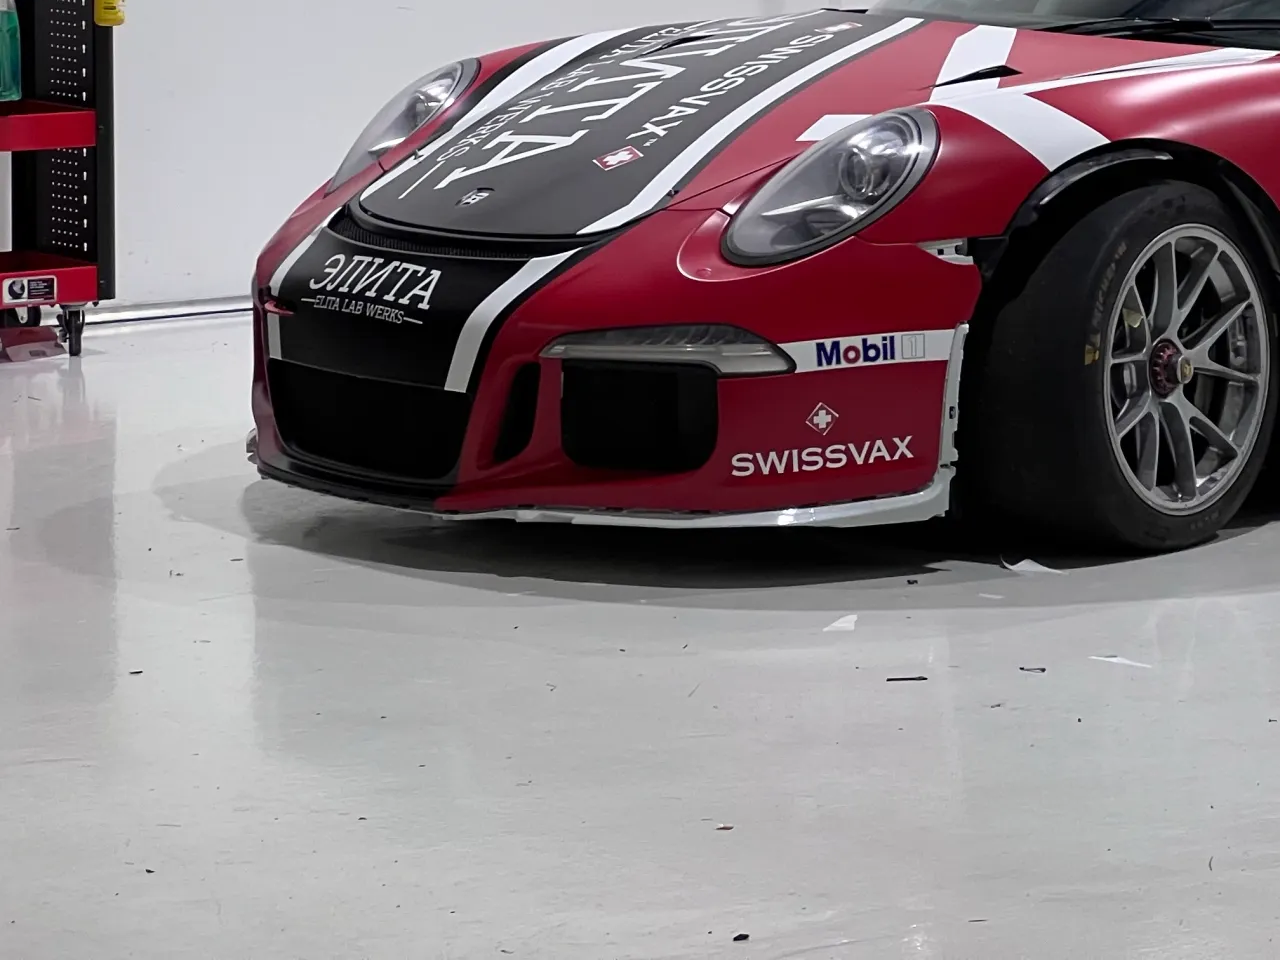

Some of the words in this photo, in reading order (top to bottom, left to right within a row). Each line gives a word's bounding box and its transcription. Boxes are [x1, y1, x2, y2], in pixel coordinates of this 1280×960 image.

[626, 34, 835, 140] SWISSVAX
[309, 253, 442, 310] ЭЛИТА
[314, 295, 340, 311] ELITA
[341, 299, 363, 314] LAB
[366, 303, 404, 324] WERKS
[816, 335, 895, 367] Mobil
[731, 435, 914, 477] SWISSVAX
